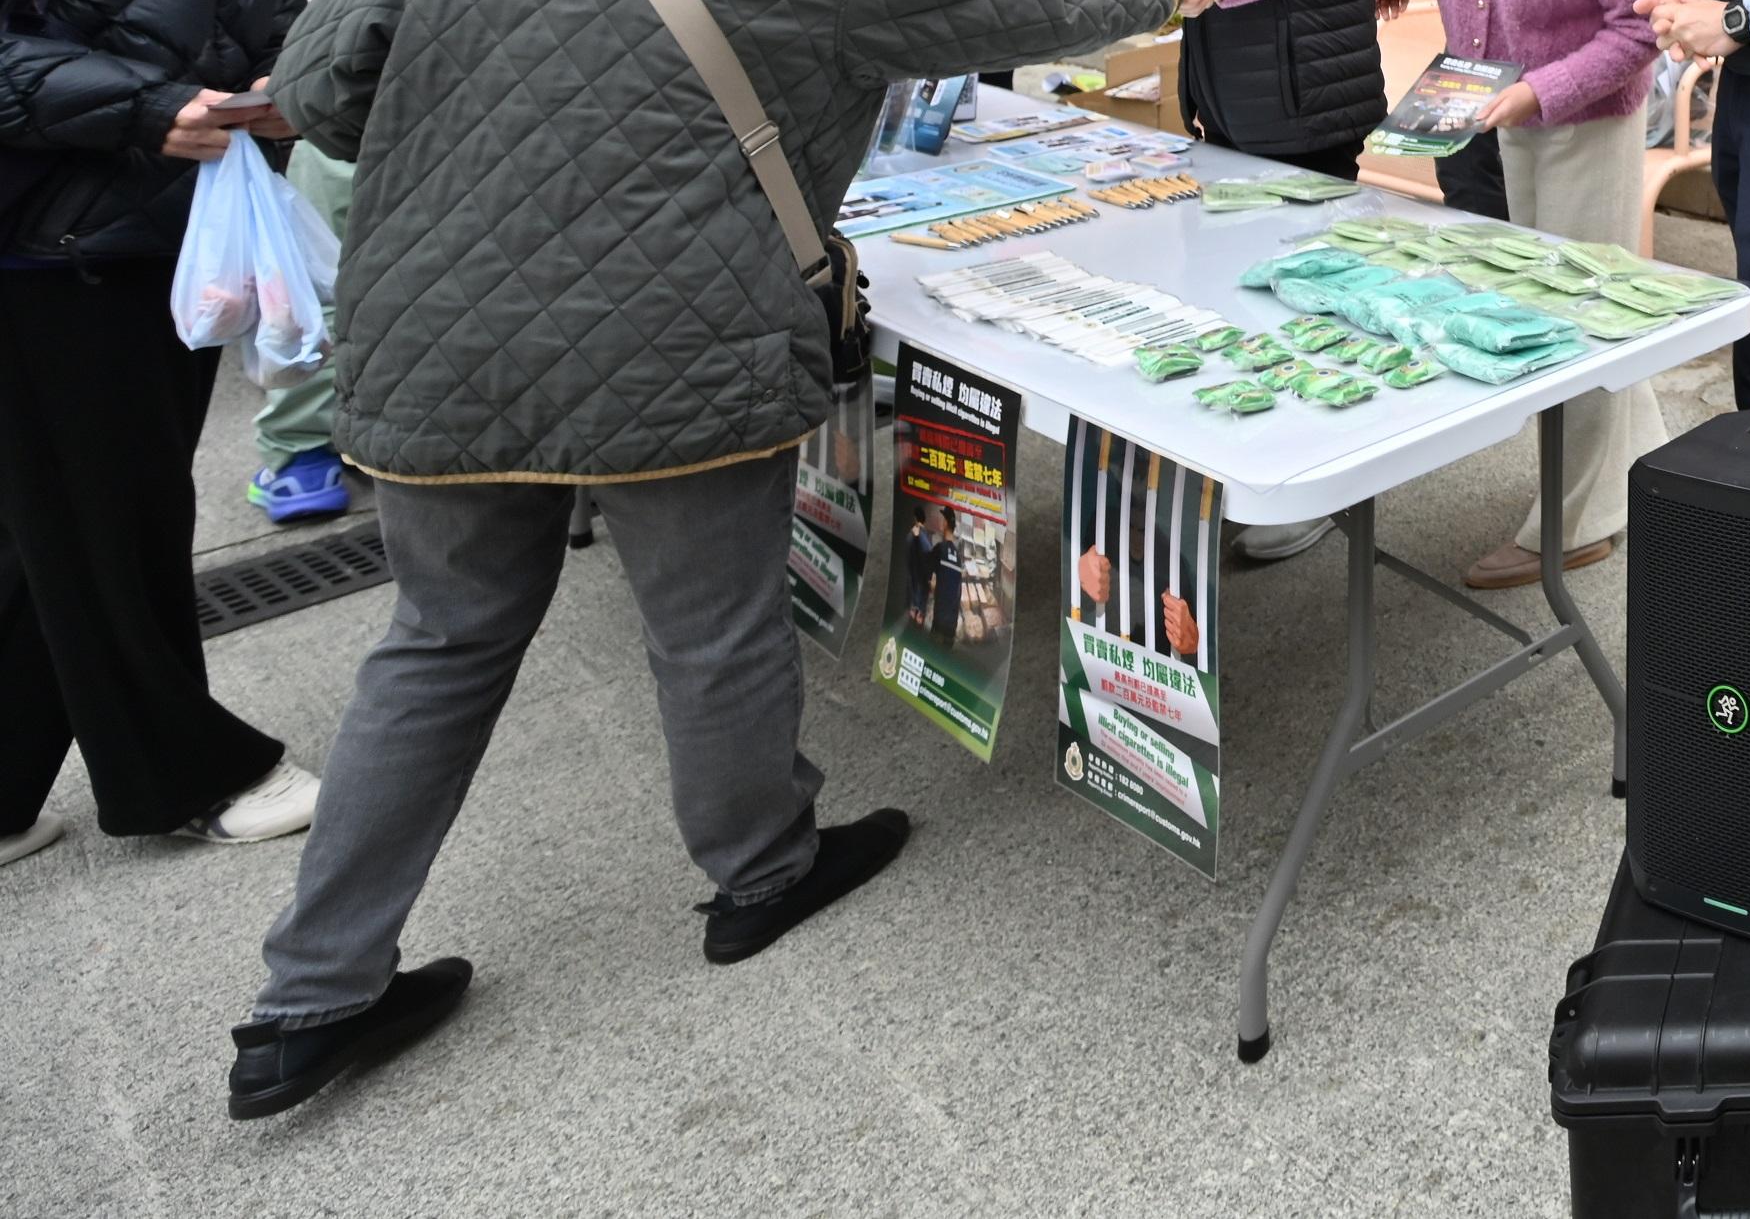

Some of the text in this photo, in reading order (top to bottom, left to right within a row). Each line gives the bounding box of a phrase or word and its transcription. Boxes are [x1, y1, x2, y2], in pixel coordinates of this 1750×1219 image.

[1083, 633, 1197, 699] 買賣私煙 均屬違法
[1113, 708, 1139, 734] Buying
[1151, 735, 1175, 764] selling
[1118, 727, 1155, 764] cigarettes
[1165, 756, 1189, 789] illegal
